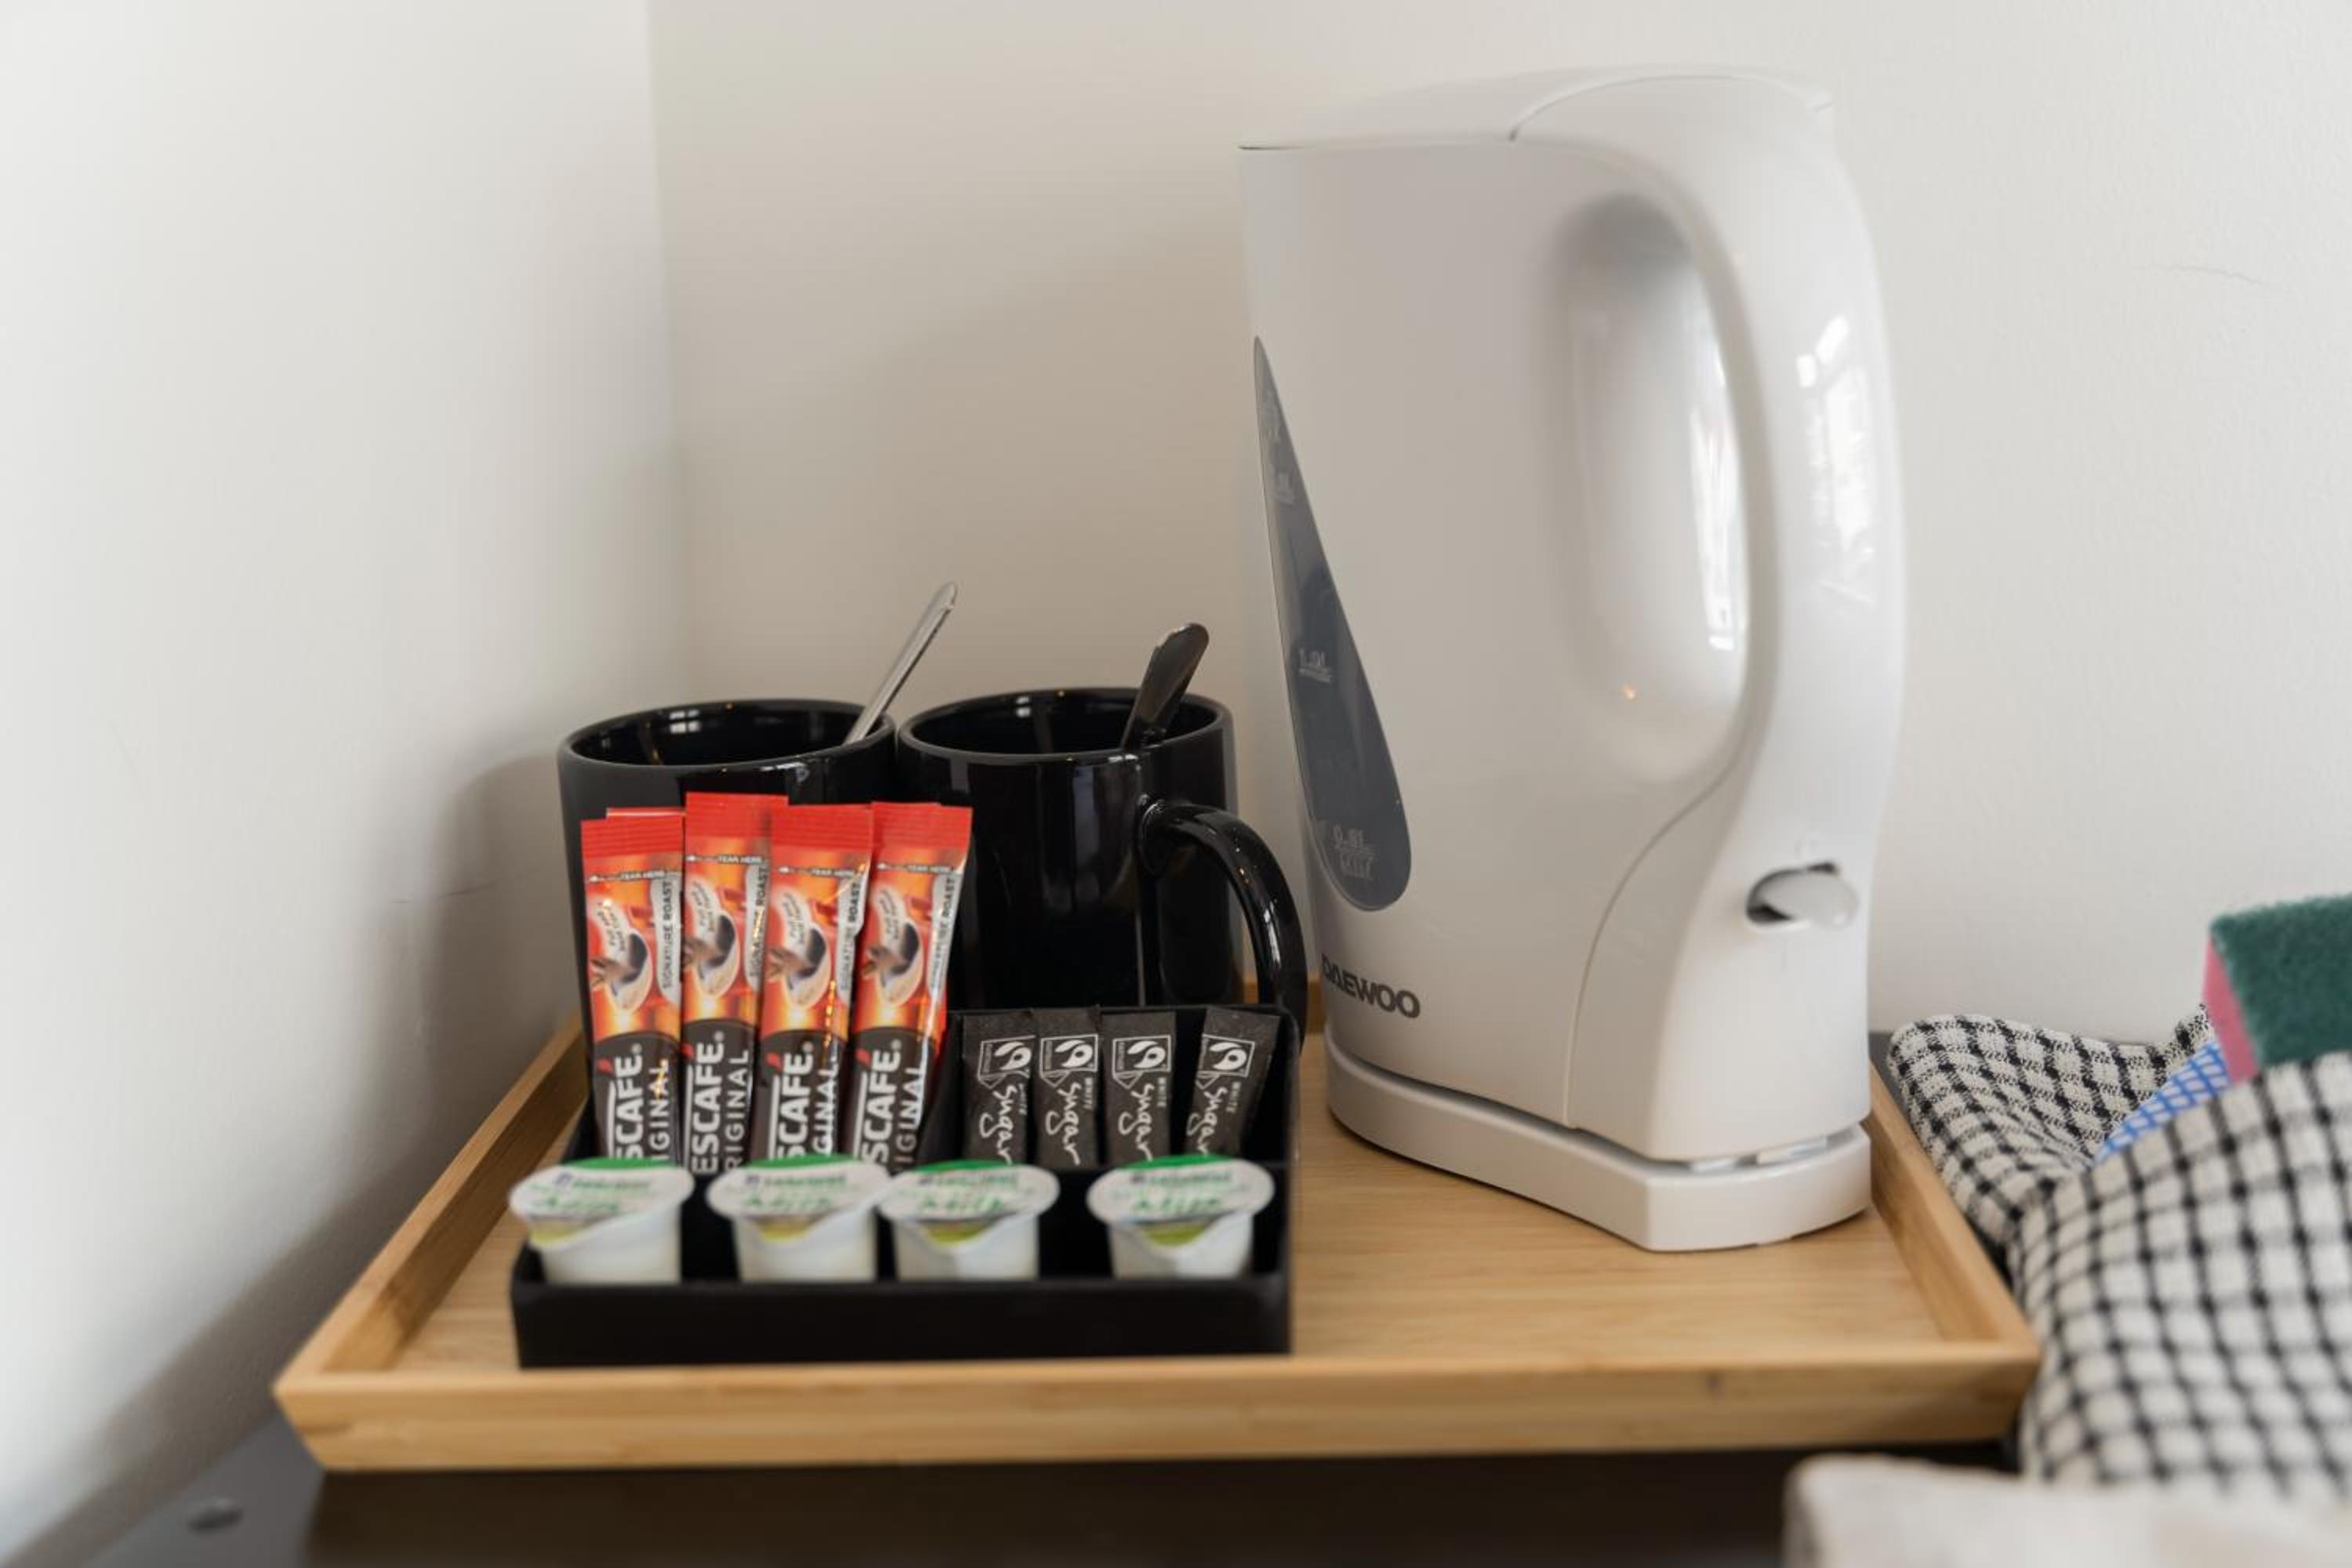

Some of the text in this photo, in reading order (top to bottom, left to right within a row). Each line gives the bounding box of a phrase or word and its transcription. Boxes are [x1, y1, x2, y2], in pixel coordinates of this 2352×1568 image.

[662, 881, 673, 989] SIGNATURE ROAST
[755, 866, 768, 906] ROAST
[848, 883, 861, 922] ROAST
[1321, 953, 1421, 1018] DAEWOO
[648, 1059, 670, 1160] IGINAL
[681, 1042, 724, 1174] ESCAFÉ
[724, 1050, 750, 1170] RIGINAL
[812, 1062, 839, 1156] GINAL
[894, 1060, 927, 1163] IGINAL
